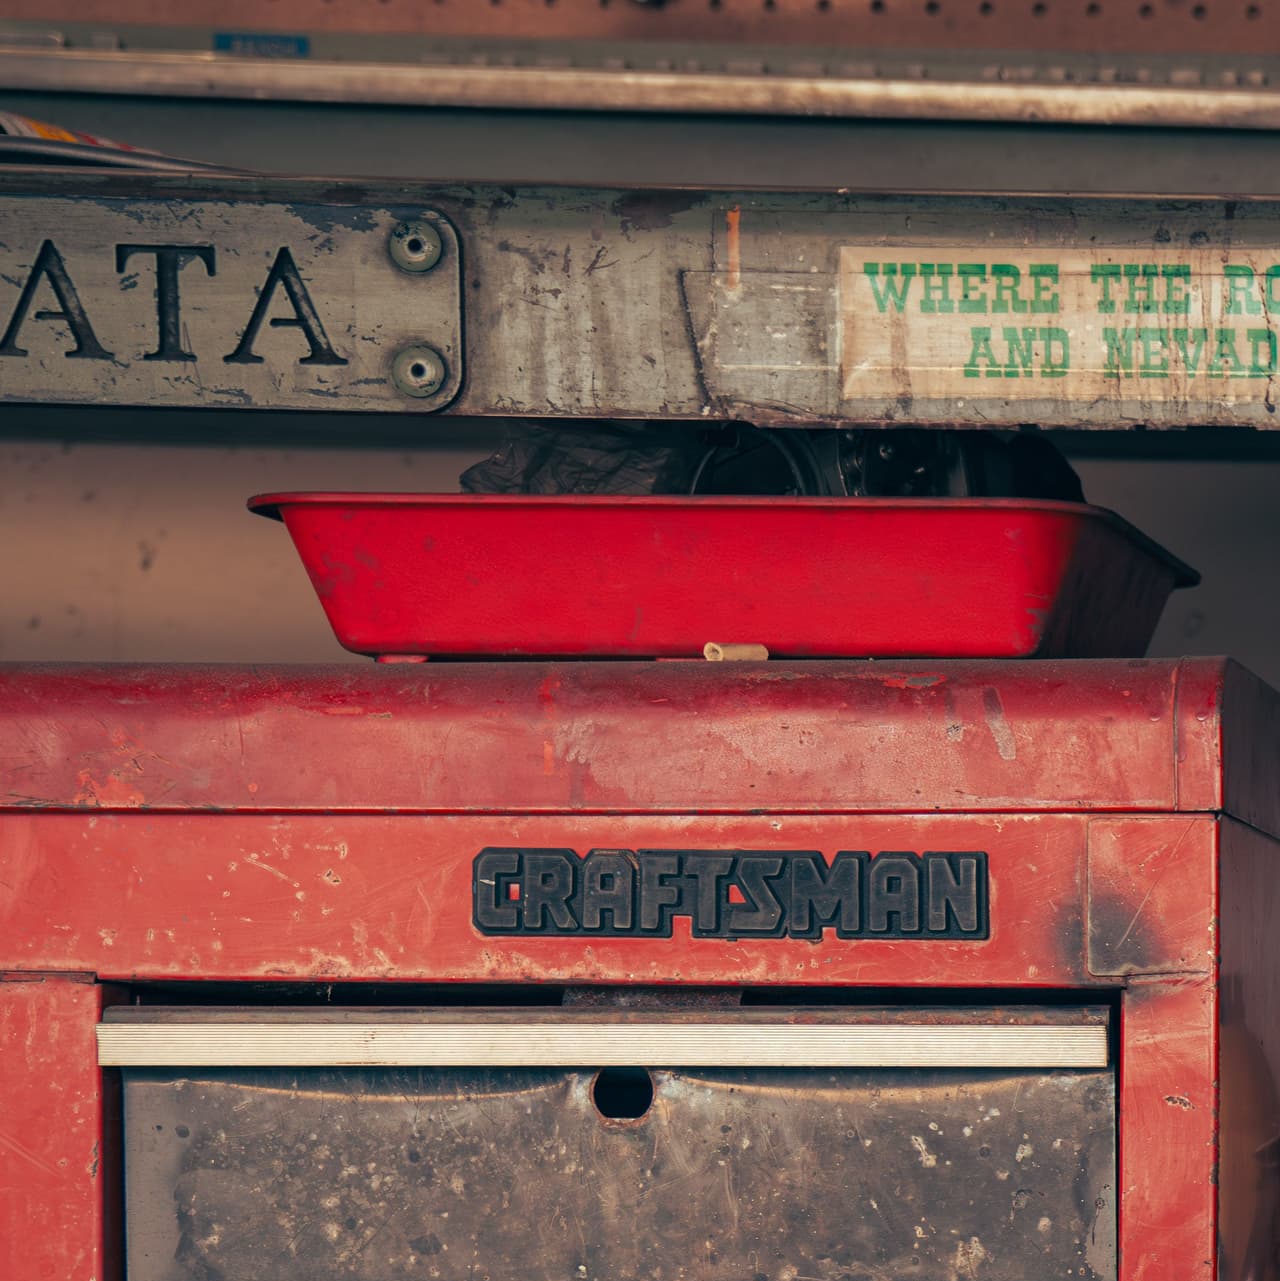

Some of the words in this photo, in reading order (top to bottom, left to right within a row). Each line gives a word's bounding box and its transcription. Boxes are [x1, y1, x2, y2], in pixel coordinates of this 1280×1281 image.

[1, 238, 349, 367] ATA
[863, 263, 1060, 315] WHERE
[1089, 263, 1192, 316] THE
[962, 326, 1070, 379] AND
[473, 847, 990, 940] CRAFTSMAN
